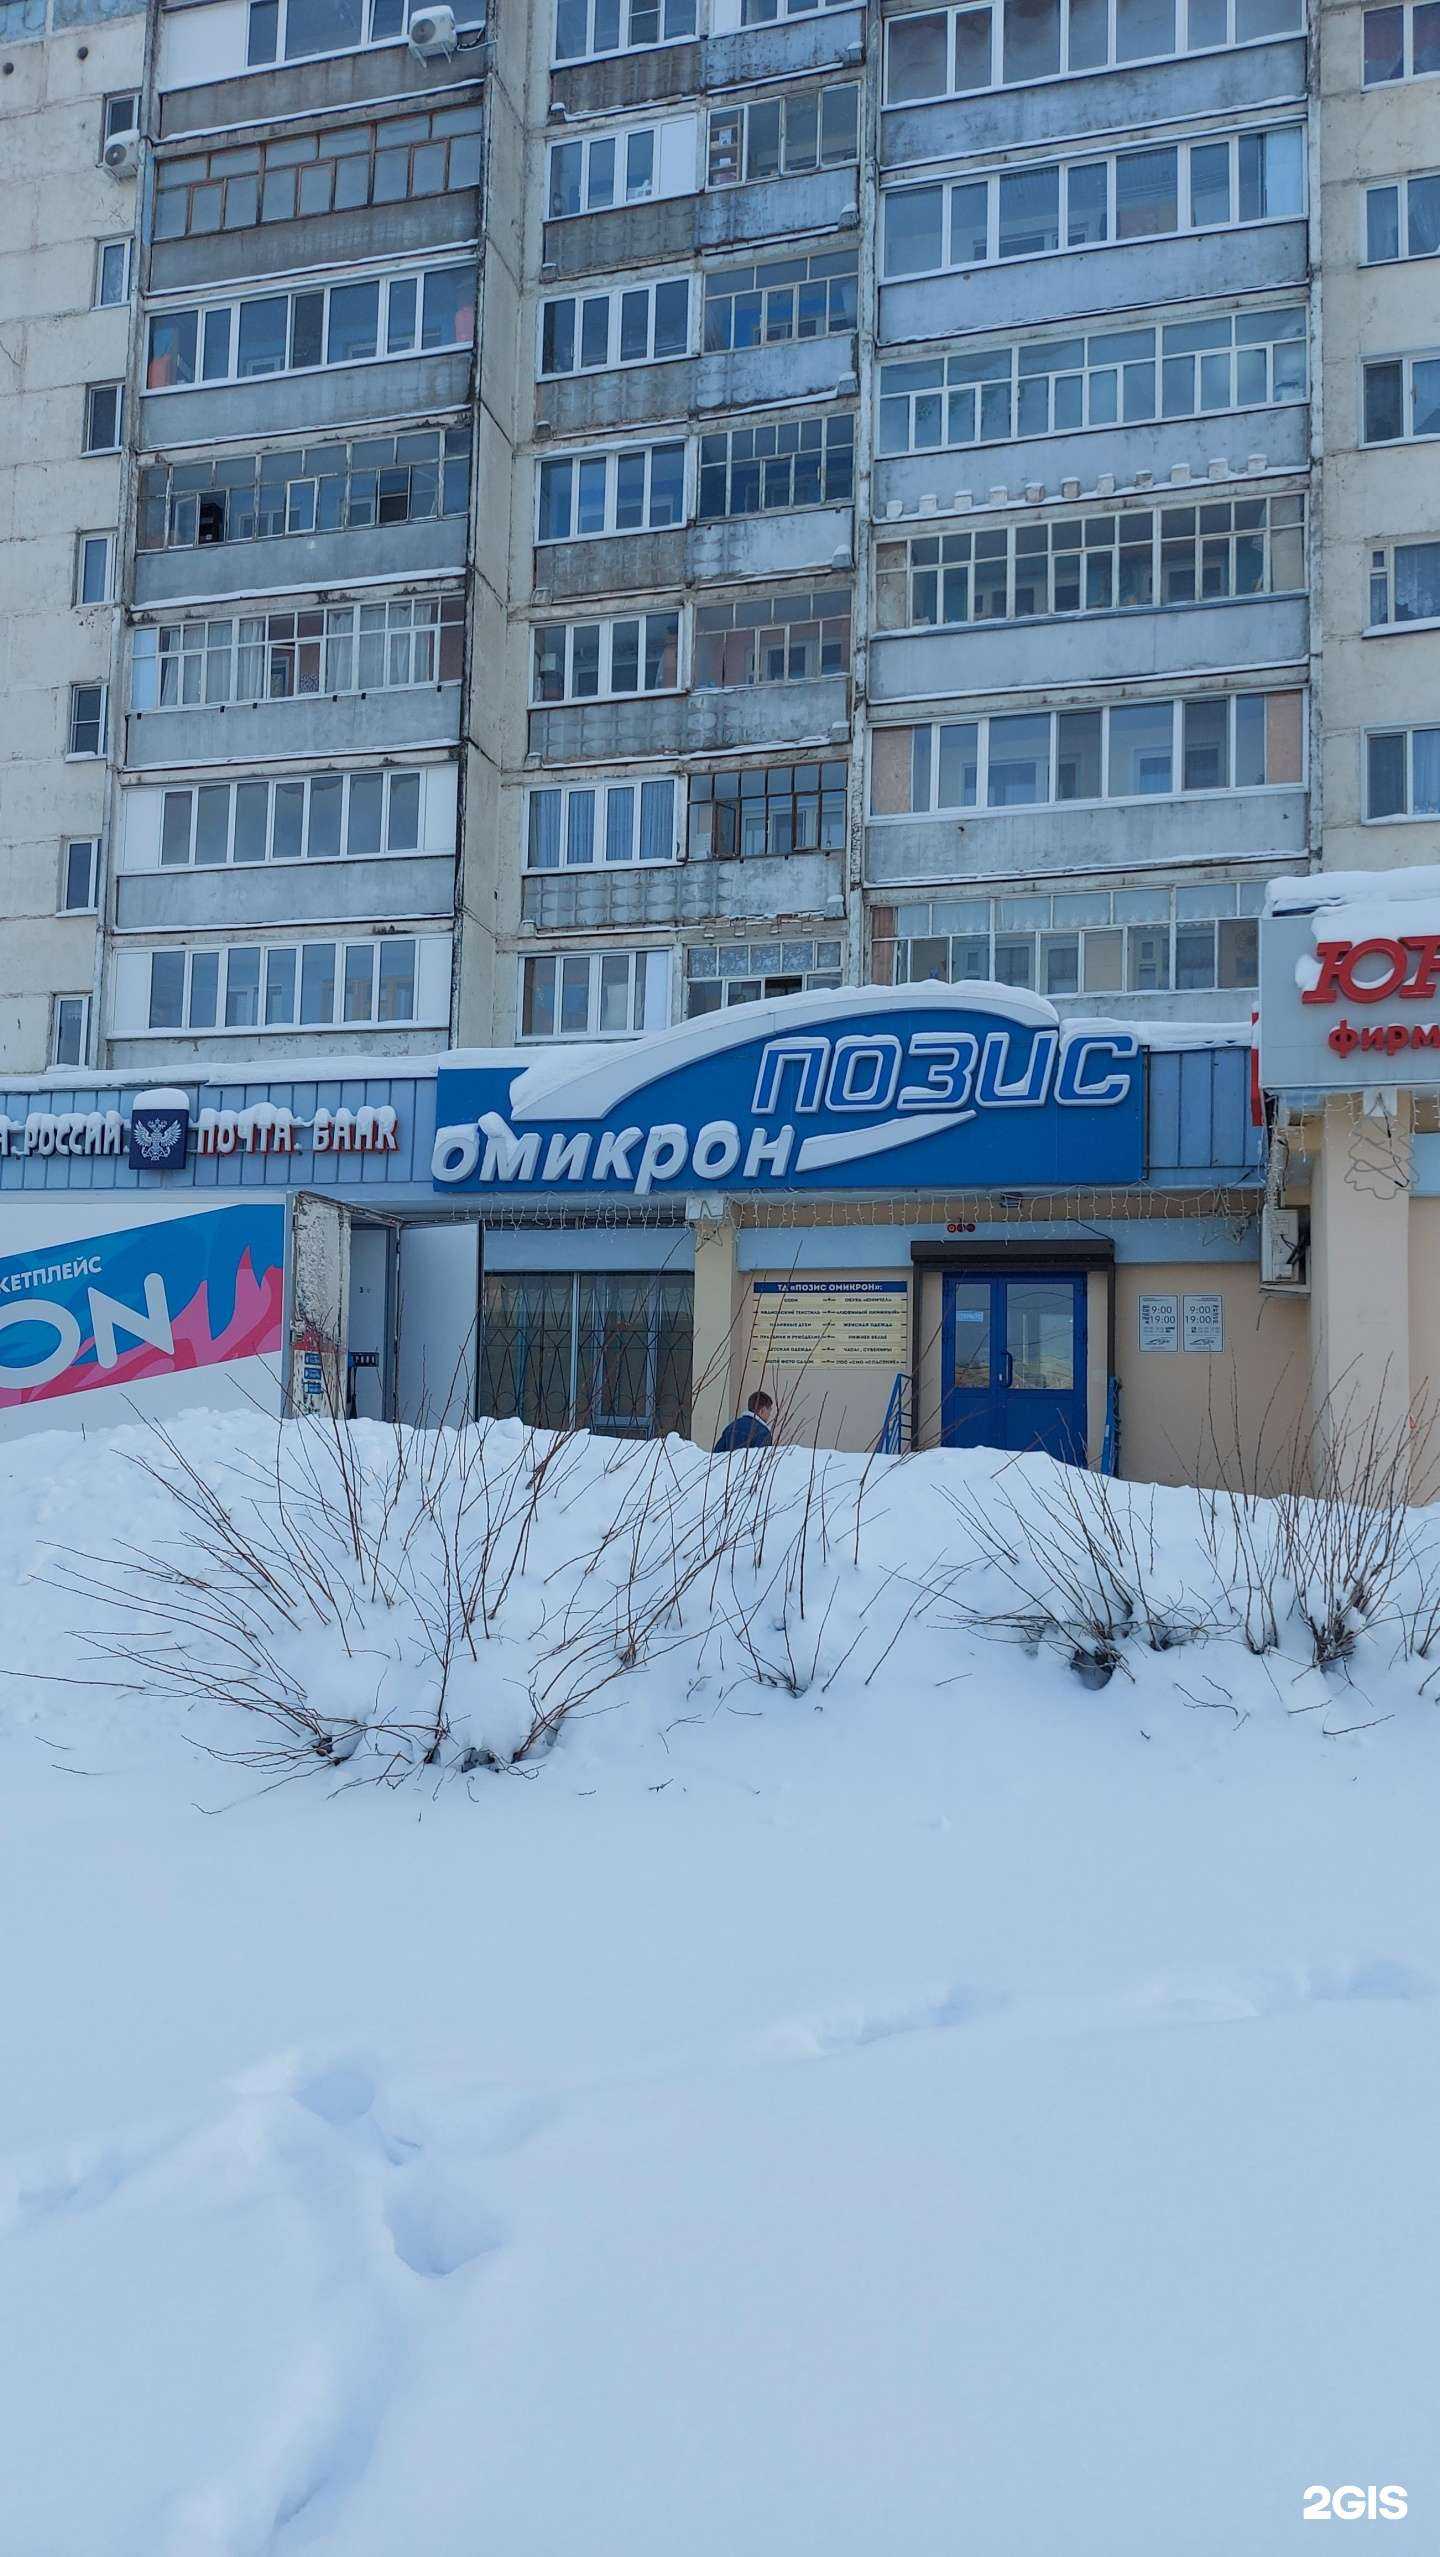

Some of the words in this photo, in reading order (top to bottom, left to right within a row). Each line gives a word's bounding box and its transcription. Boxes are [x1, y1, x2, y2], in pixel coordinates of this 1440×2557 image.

[751, 1031, 1137, 1114] ПОЗИС
[24, 1114, 121, 1156] РОССИИ
[198, 1112, 293, 1154] ПОЧТА
[313, 1112, 398, 1153] БАНК
[1151, 1305, 1172, 1314] 9:00
[1190, 1305, 1211, 1314] 9:00
[1150, 1316, 1176, 1324] 19:00
[1185, 1316, 1212, 1324] 19:00
